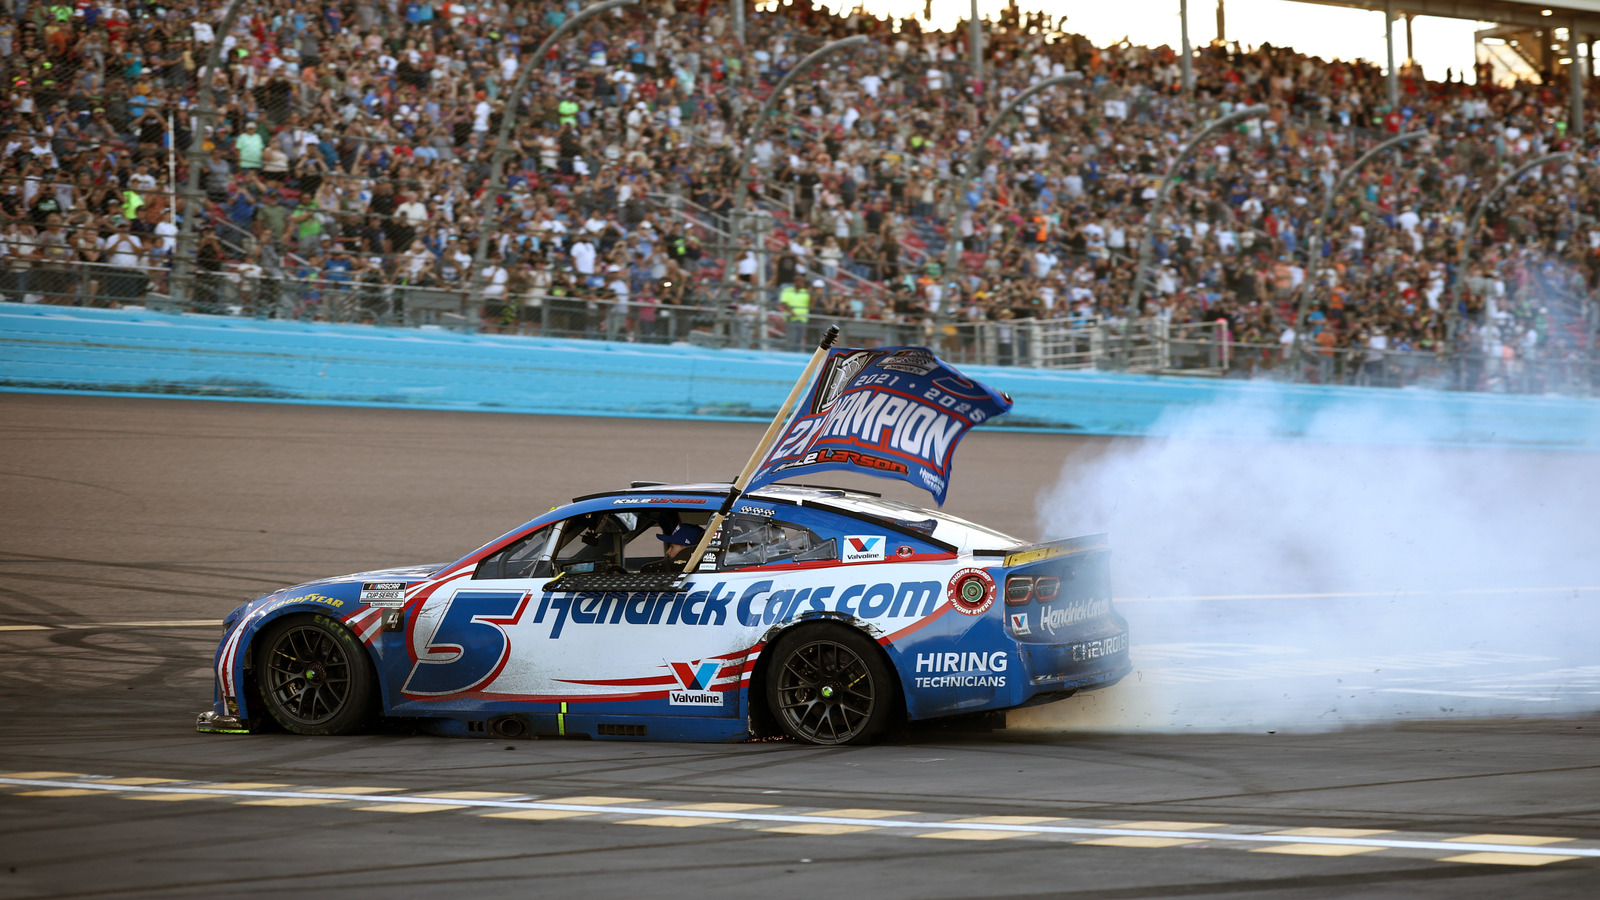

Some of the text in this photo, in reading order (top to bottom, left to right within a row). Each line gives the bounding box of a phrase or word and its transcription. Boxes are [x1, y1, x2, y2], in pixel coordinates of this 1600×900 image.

[854, 373, 899, 387] 2021
[770, 390, 962, 467] 2X HAMPION
[971, 569, 992, 581] ENERGY
[268, 593, 344, 608] GOODYEAR
[973, 595, 994, 614] ENERGY
[387, 612, 400, 629] 4
[400, 589, 532, 699] 5
[915, 651, 1008, 673] HIRING
[915, 676, 1006, 688] TECHNICIANS
[672, 693, 720, 704] Valvoline
